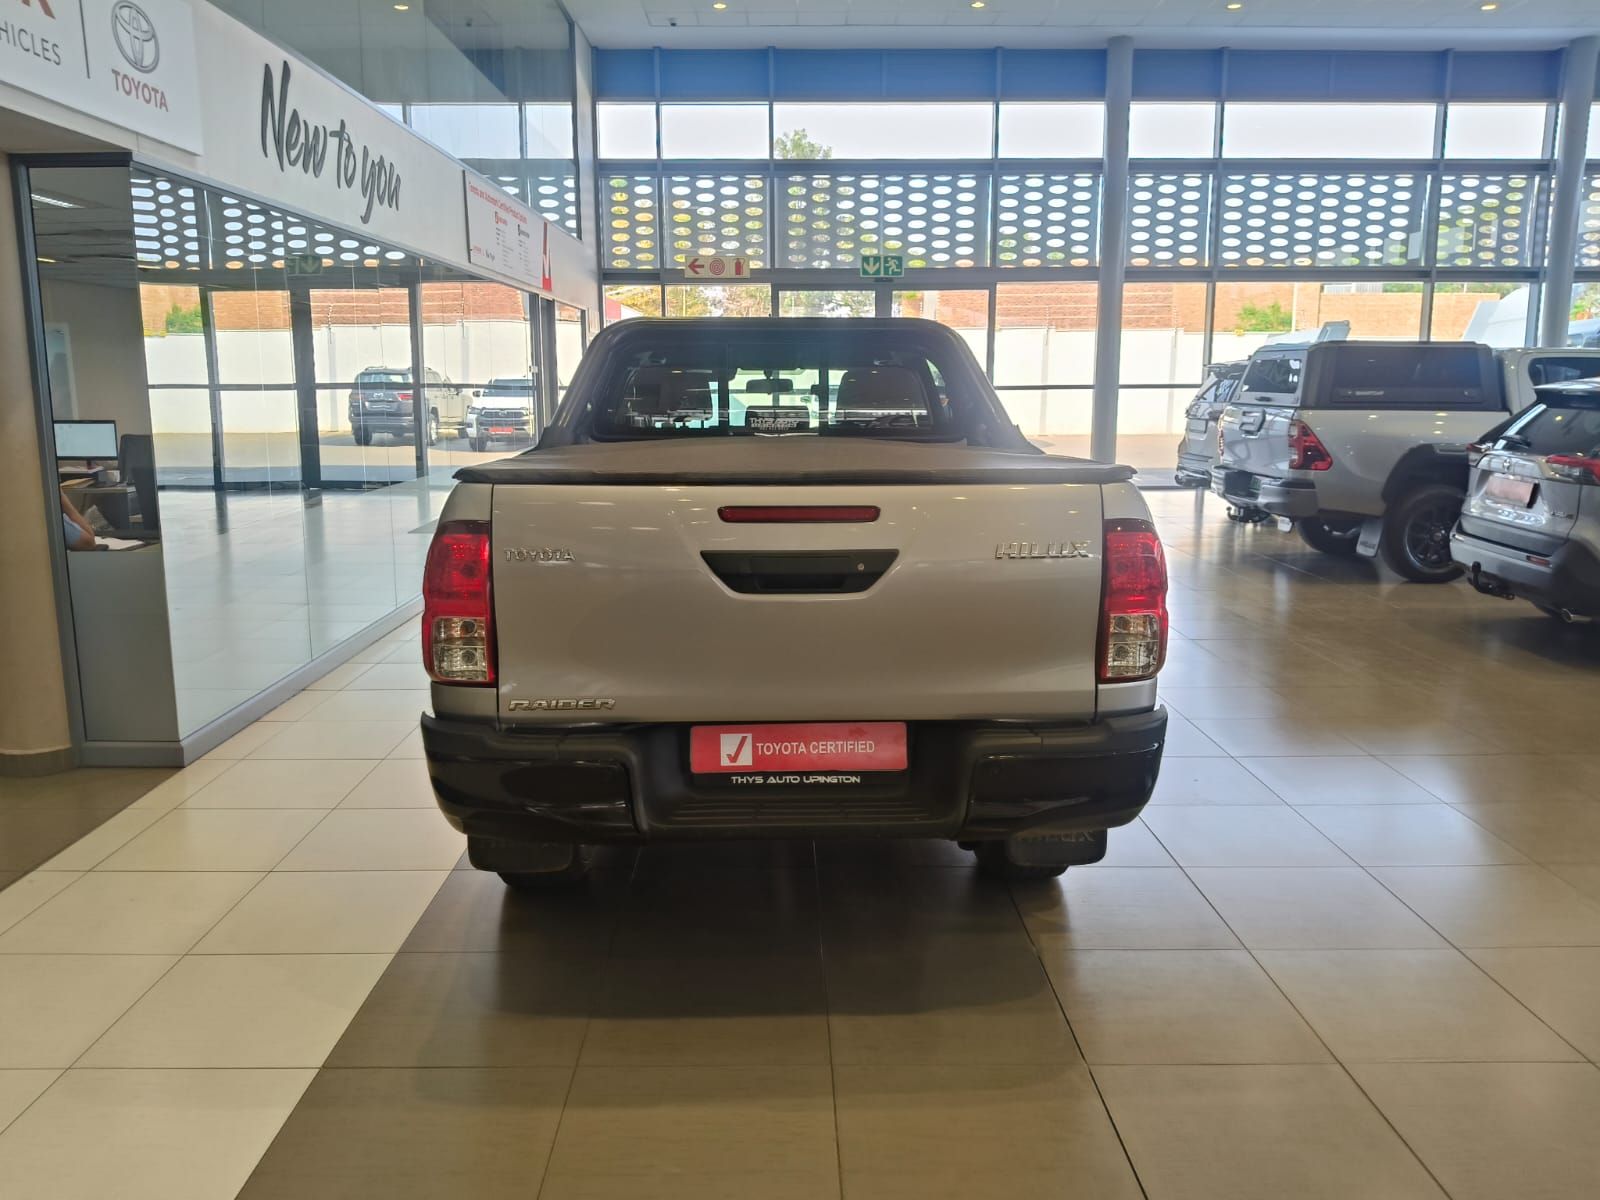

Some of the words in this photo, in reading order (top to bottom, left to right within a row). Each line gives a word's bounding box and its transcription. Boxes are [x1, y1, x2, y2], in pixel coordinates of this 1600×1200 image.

[111, 68, 169, 113] TOYOTA
[261, 60, 328, 179] New
[329, 119, 357, 190] to
[360, 145, 402, 225] you
[503, 547, 576, 562] TOYOTA
[994, 541, 1092, 560] HILUX
[508, 698, 616, 712] RAIDER
[756, 742, 807, 756] TOYOTA
[809, 740, 875, 754] CERTIFIED
[731, 776, 763, 784] THYS
[766, 775, 800, 784] AUTO
[803, 775, 861, 783] UPINGTON
